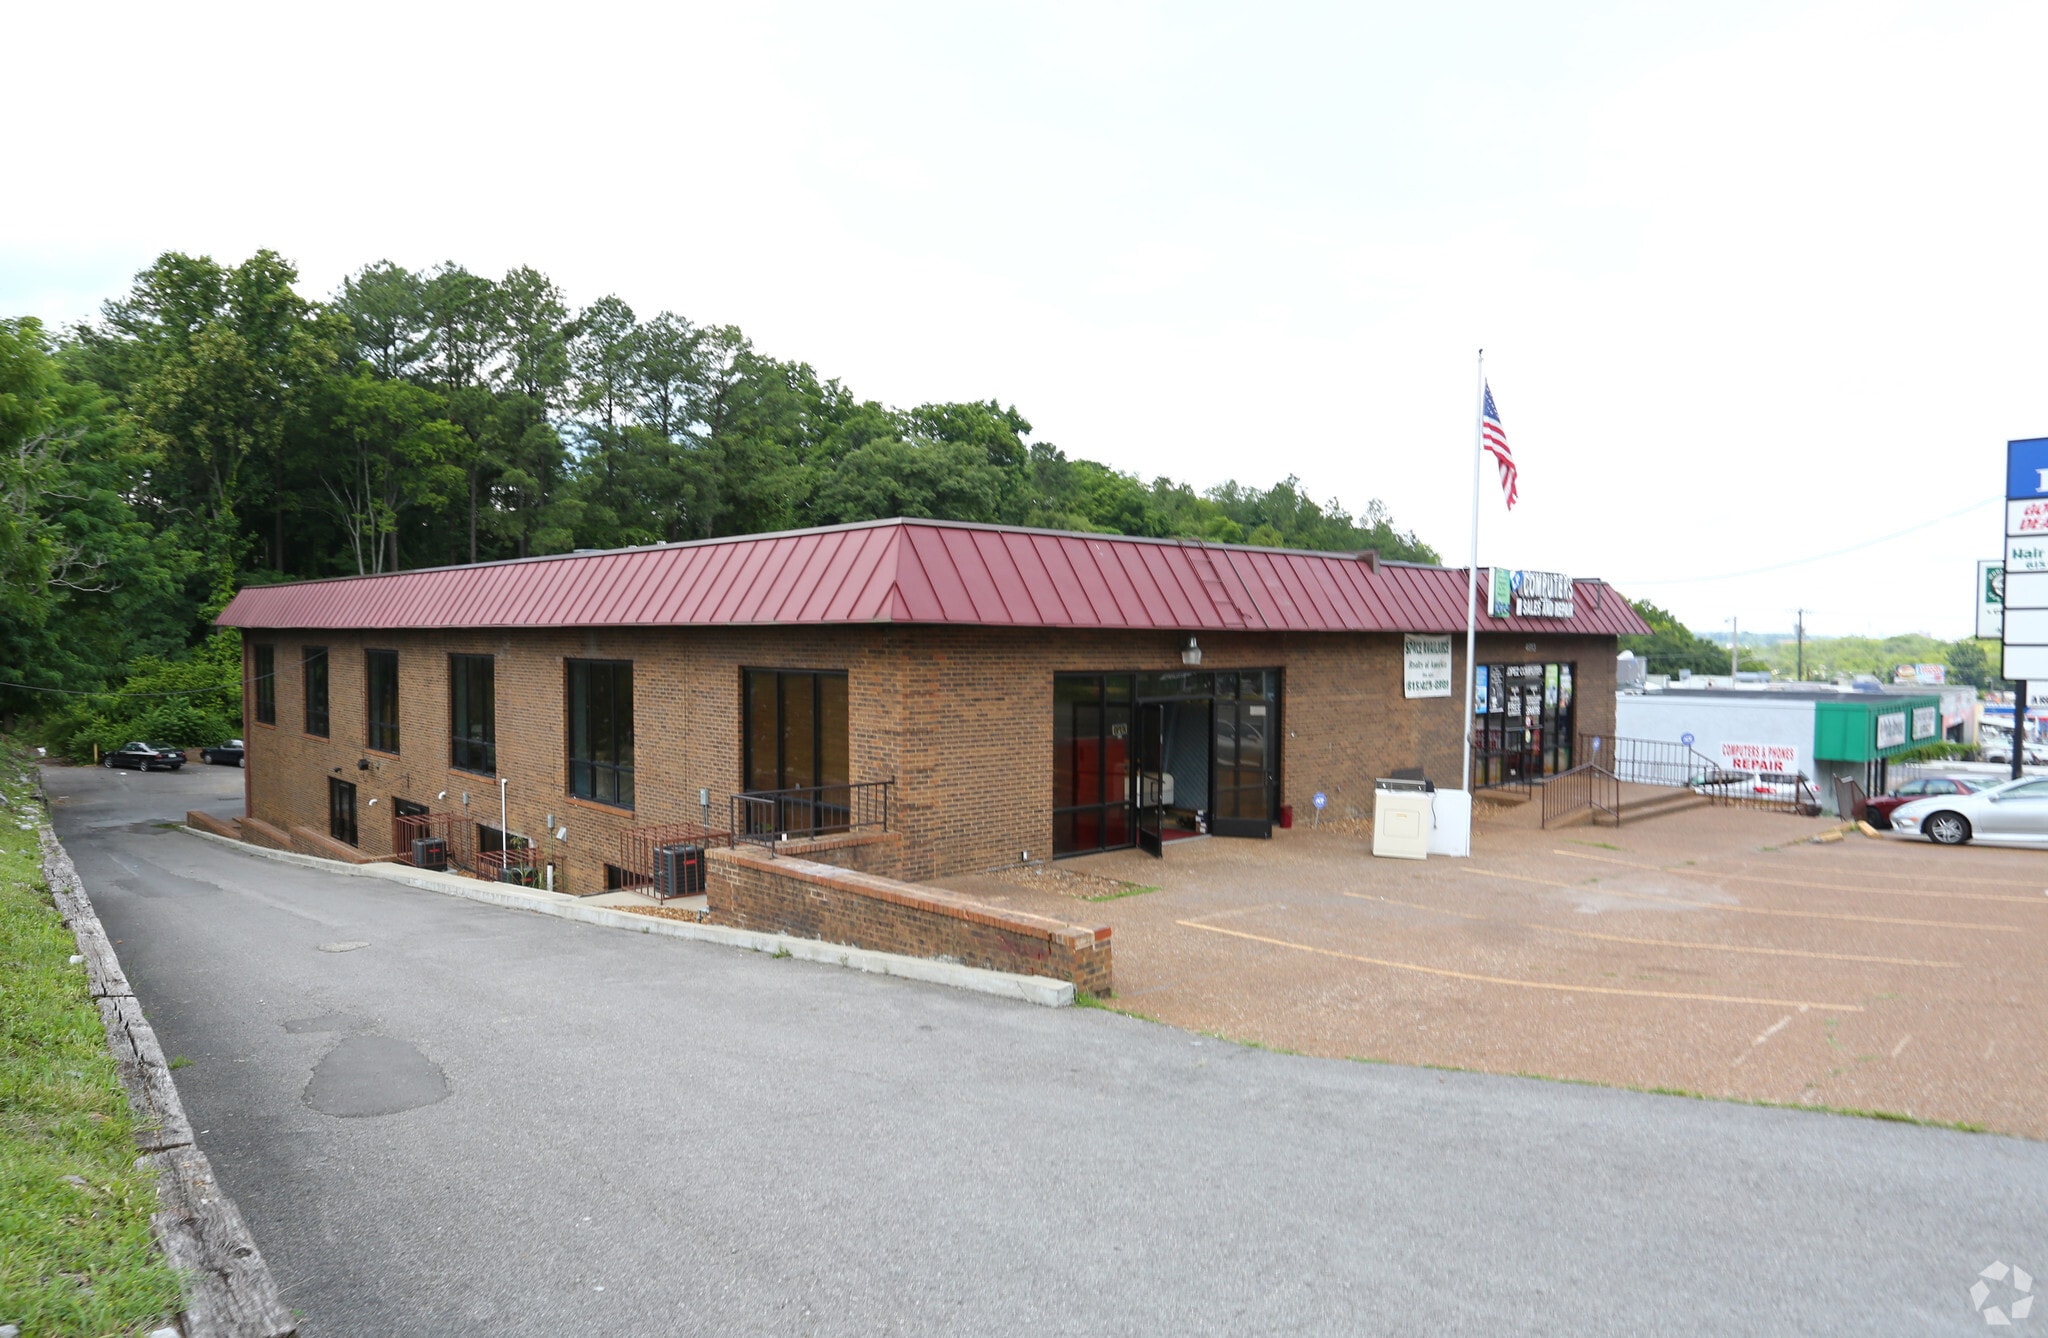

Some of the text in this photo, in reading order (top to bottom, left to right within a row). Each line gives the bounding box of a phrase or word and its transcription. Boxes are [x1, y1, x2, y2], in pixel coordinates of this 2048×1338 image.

[1523, 572, 1573, 599] COMPUTERS
[1722, 743, 1760, 758] COMPUTERS
[1768, 746, 1794, 761] PHONES
[1733, 758, 1783, 772] REPAIR
